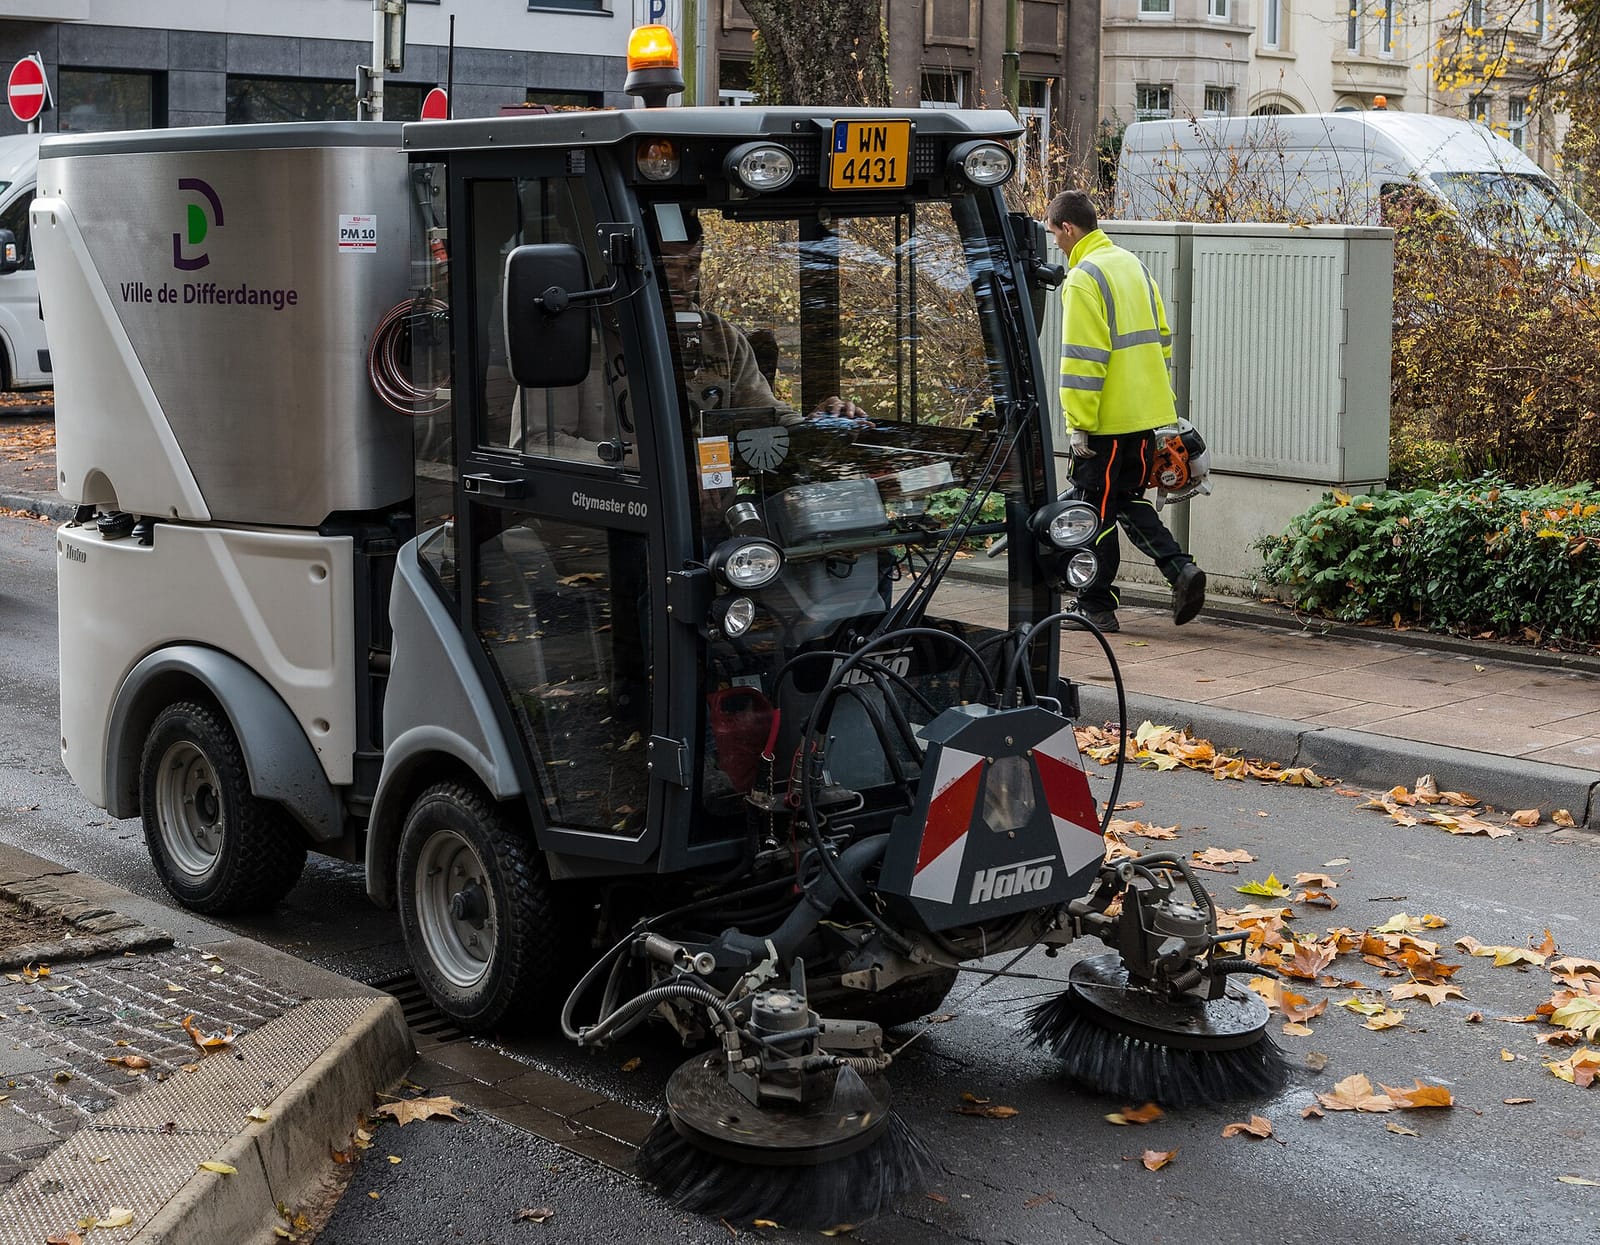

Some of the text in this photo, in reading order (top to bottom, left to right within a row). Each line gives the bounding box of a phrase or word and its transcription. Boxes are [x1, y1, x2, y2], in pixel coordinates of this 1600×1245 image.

[649, 0, 666, 24] P
[837, 140, 844, 150] L
[859, 127, 887, 153] WN
[842, 157, 897, 184] 4431
[340, 229, 376, 239] PM 10
[120, 282, 298, 311] Ville de Differdange
[571, 491, 648, 517] Citymaster 600
[968, 854, 1056, 905] Hako
